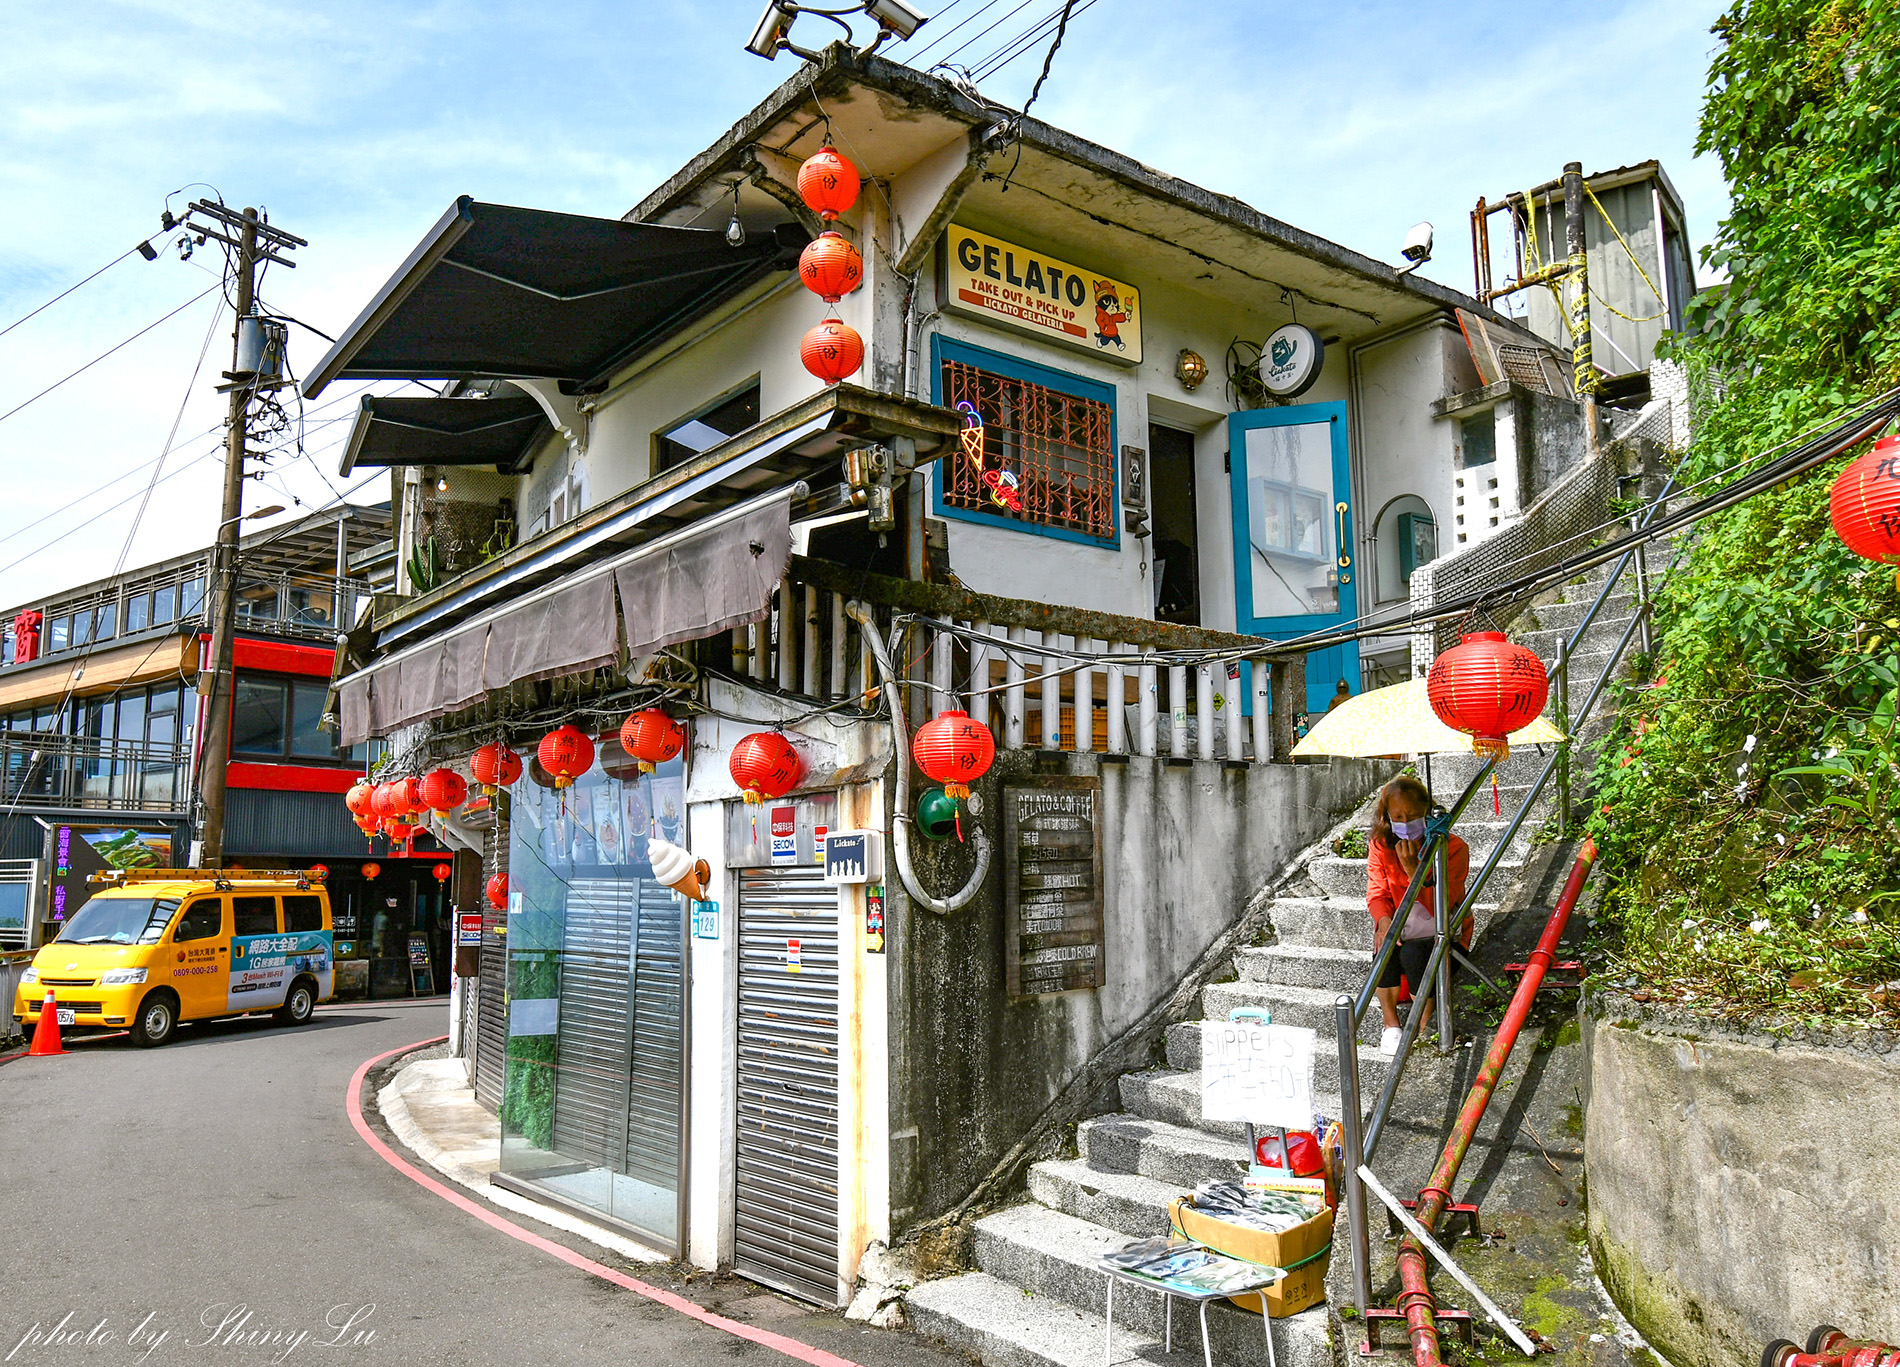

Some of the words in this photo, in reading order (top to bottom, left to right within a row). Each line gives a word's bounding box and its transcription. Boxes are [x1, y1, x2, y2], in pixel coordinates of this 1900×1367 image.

[823, 154, 838, 190] 九份
[958, 238, 1086, 307] GELATO
[971, 278, 999, 297] TAKE
[1003, 288, 1023, 304] OUT
[1026, 296, 1034, 306] &
[1036, 299, 1059, 316] PICK
[1062, 308, 1076, 321] UP
[983, 297, 1019, 316] LICKATO
[1022, 309, 1065, 331] GELATERIA
[823, 326, 838, 360] 九份
[983, 470, 1022, 511] Coffee
[1508, 653, 1534, 716] 熱川
[960, 725, 980, 770] 九份
[773, 840, 794, 854] SECOM
[700, 917, 715, 931] 129
[248, 936, 298, 955] 網路大全配
[173, 965, 218, 977] 0809-000-258
